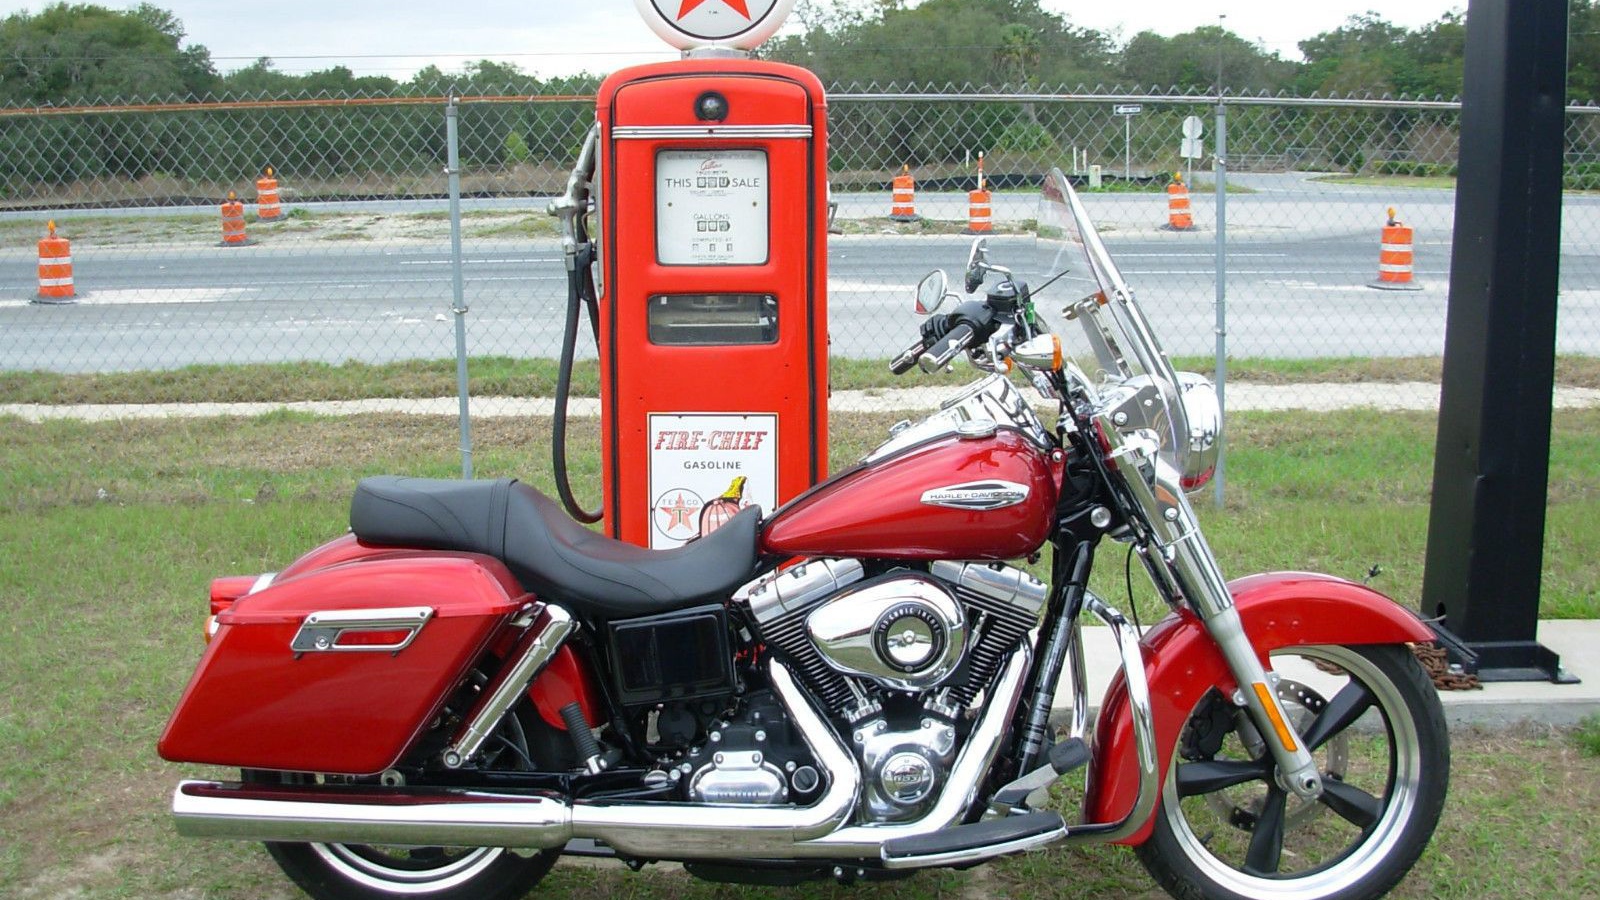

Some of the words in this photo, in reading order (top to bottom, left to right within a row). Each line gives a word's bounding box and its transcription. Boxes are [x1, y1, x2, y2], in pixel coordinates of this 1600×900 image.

[665, 178, 692, 188] THIS
[732, 178, 760, 188] SALE
[655, 430, 768, 450] FIRE-CHIEF
[683, 460, 742, 470] GASOLINE
[888, 607, 914, 620] CUBIC
